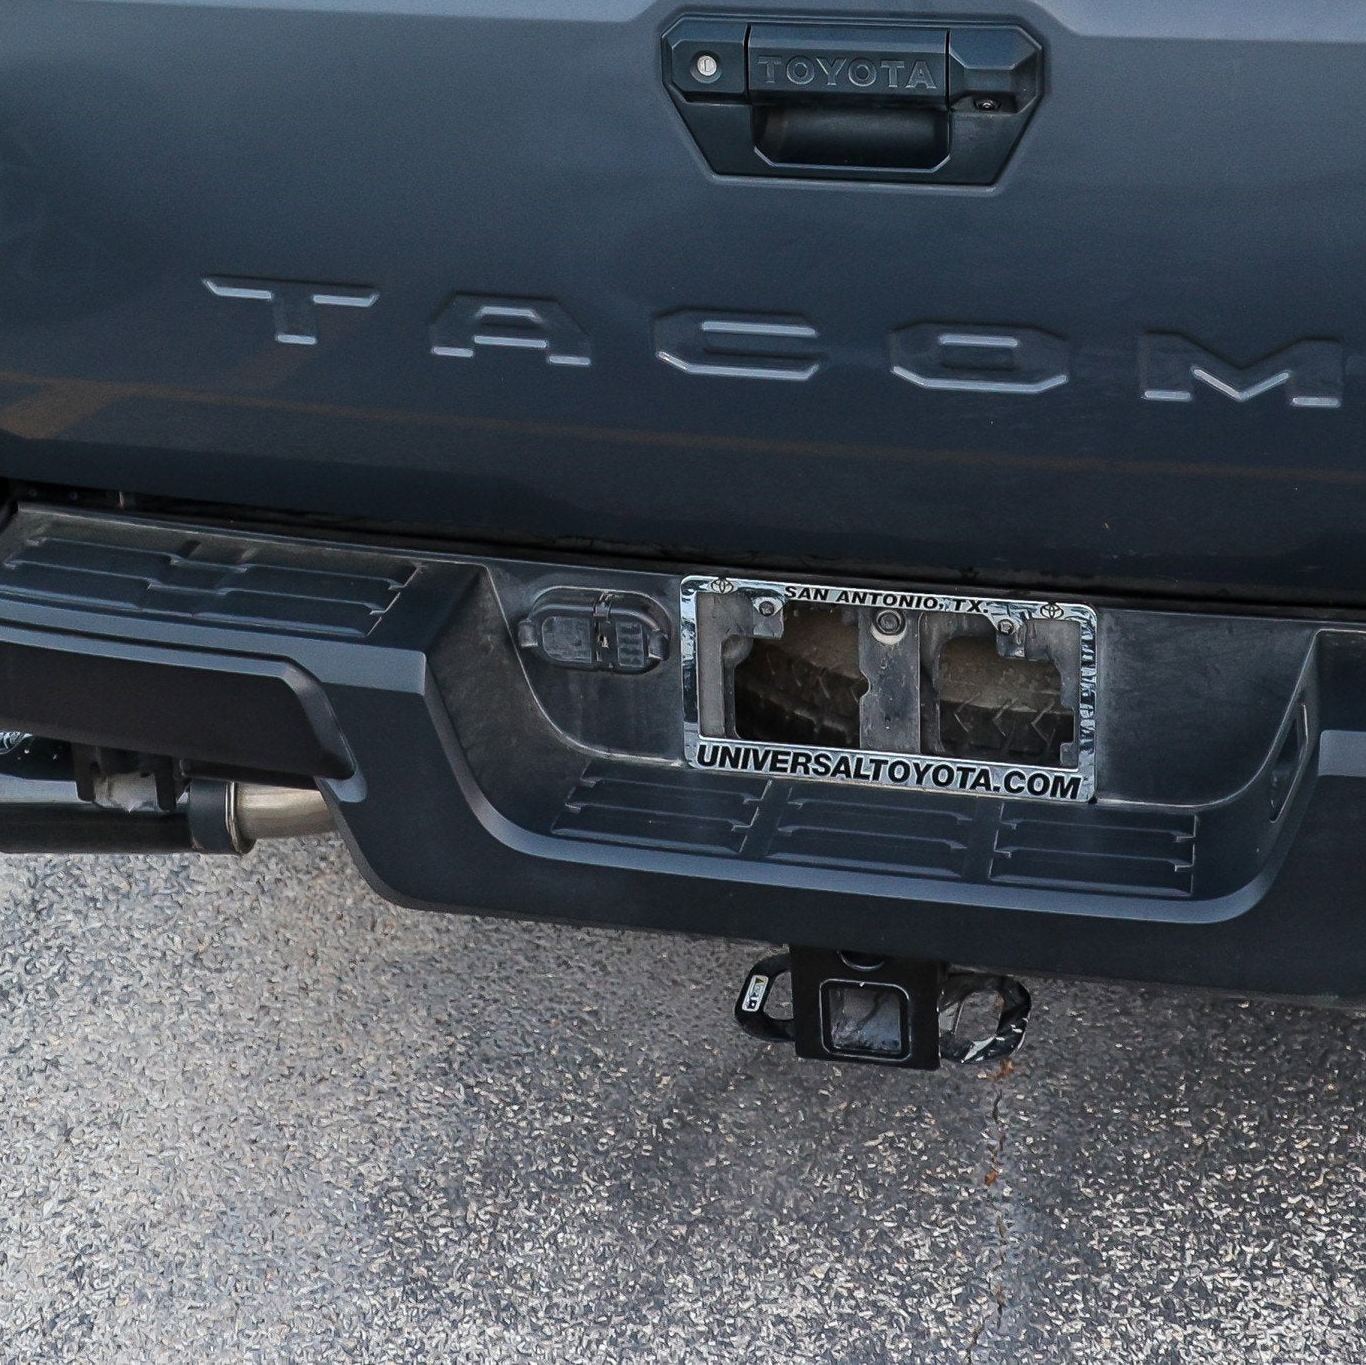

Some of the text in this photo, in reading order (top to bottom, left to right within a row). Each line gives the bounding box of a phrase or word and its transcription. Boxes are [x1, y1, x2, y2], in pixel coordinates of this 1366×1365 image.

[757, 55, 938, 90] TOYOTA
[784, 585, 990, 614] SAN ANTONIO, TX.
[696, 744, 1084, 801] UNIVERSALTOYOTA.COM
